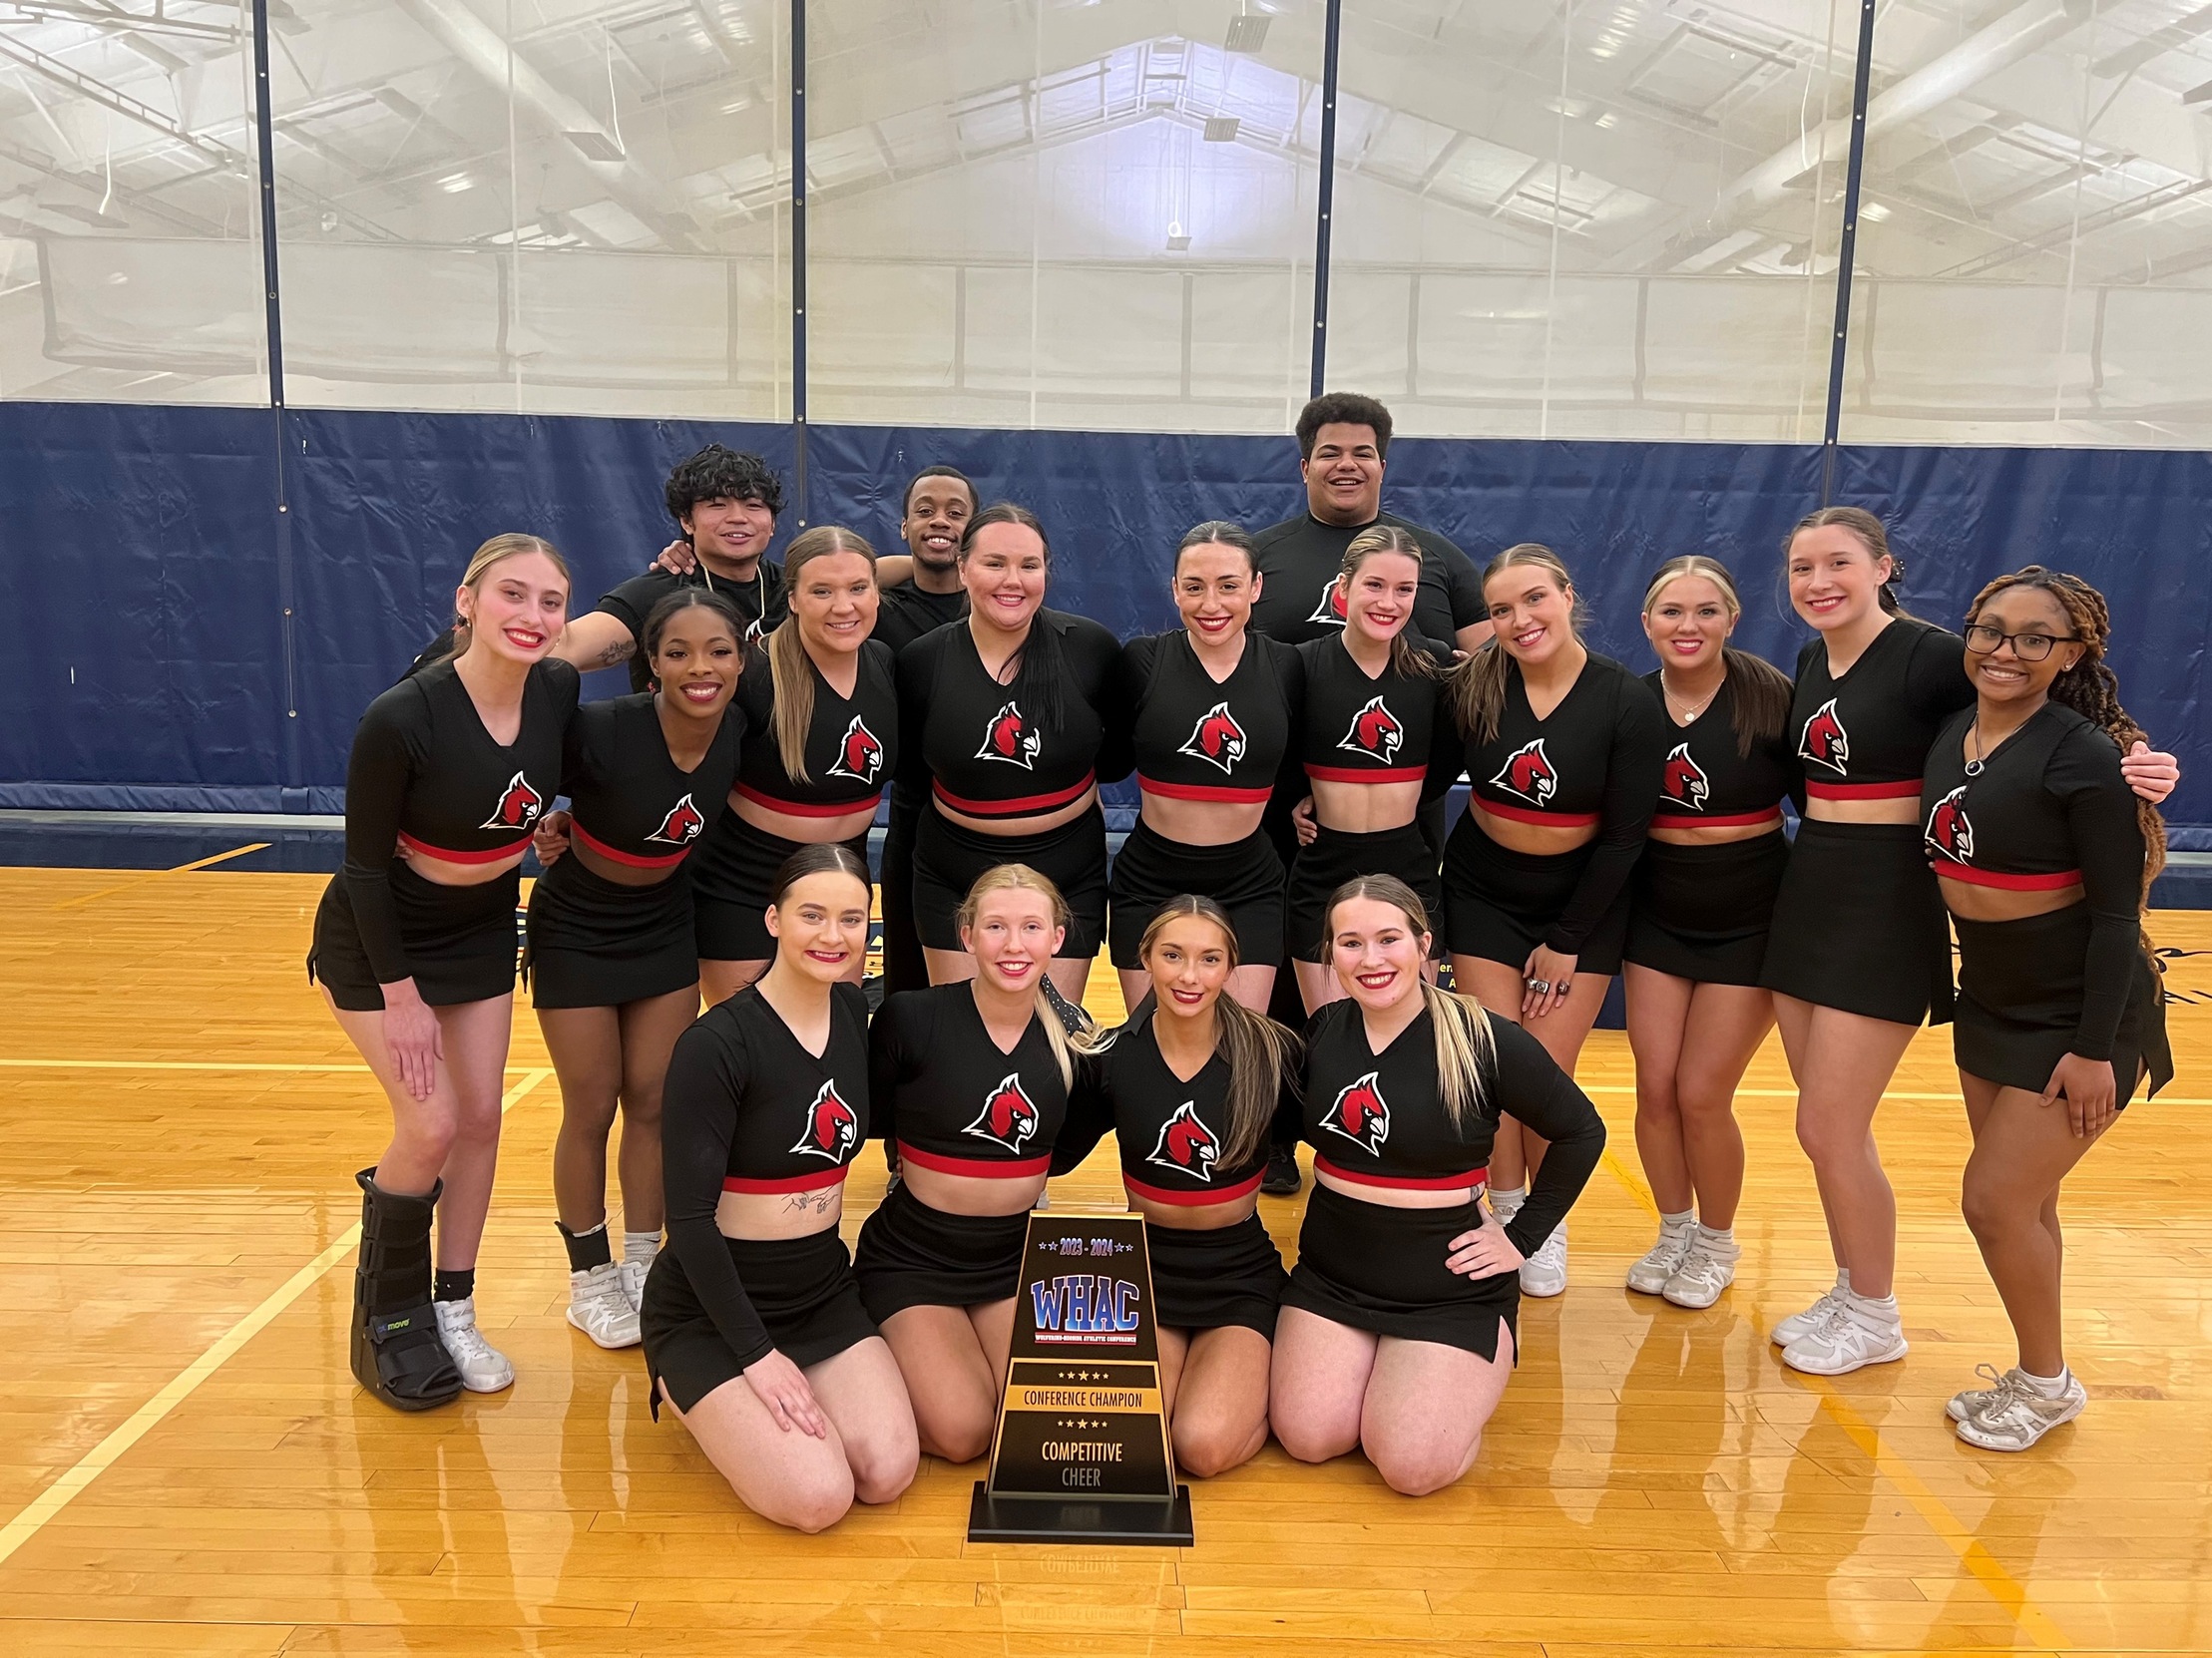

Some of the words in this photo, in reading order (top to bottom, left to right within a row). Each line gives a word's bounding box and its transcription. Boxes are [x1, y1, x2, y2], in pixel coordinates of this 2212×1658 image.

[1060, 1237, 1083, 1256] 2023
[1090, 1238, 1113, 1257] 2024
[1031, 1274, 1139, 1332] WHAC
[1024, 1390, 1087, 1407] CONFERENCE
[1089, 1392, 1142, 1408] CHAMPION
[1042, 1441, 1123, 1462] COMPETITIVE
[1062, 1466, 1102, 1487] CHEER
